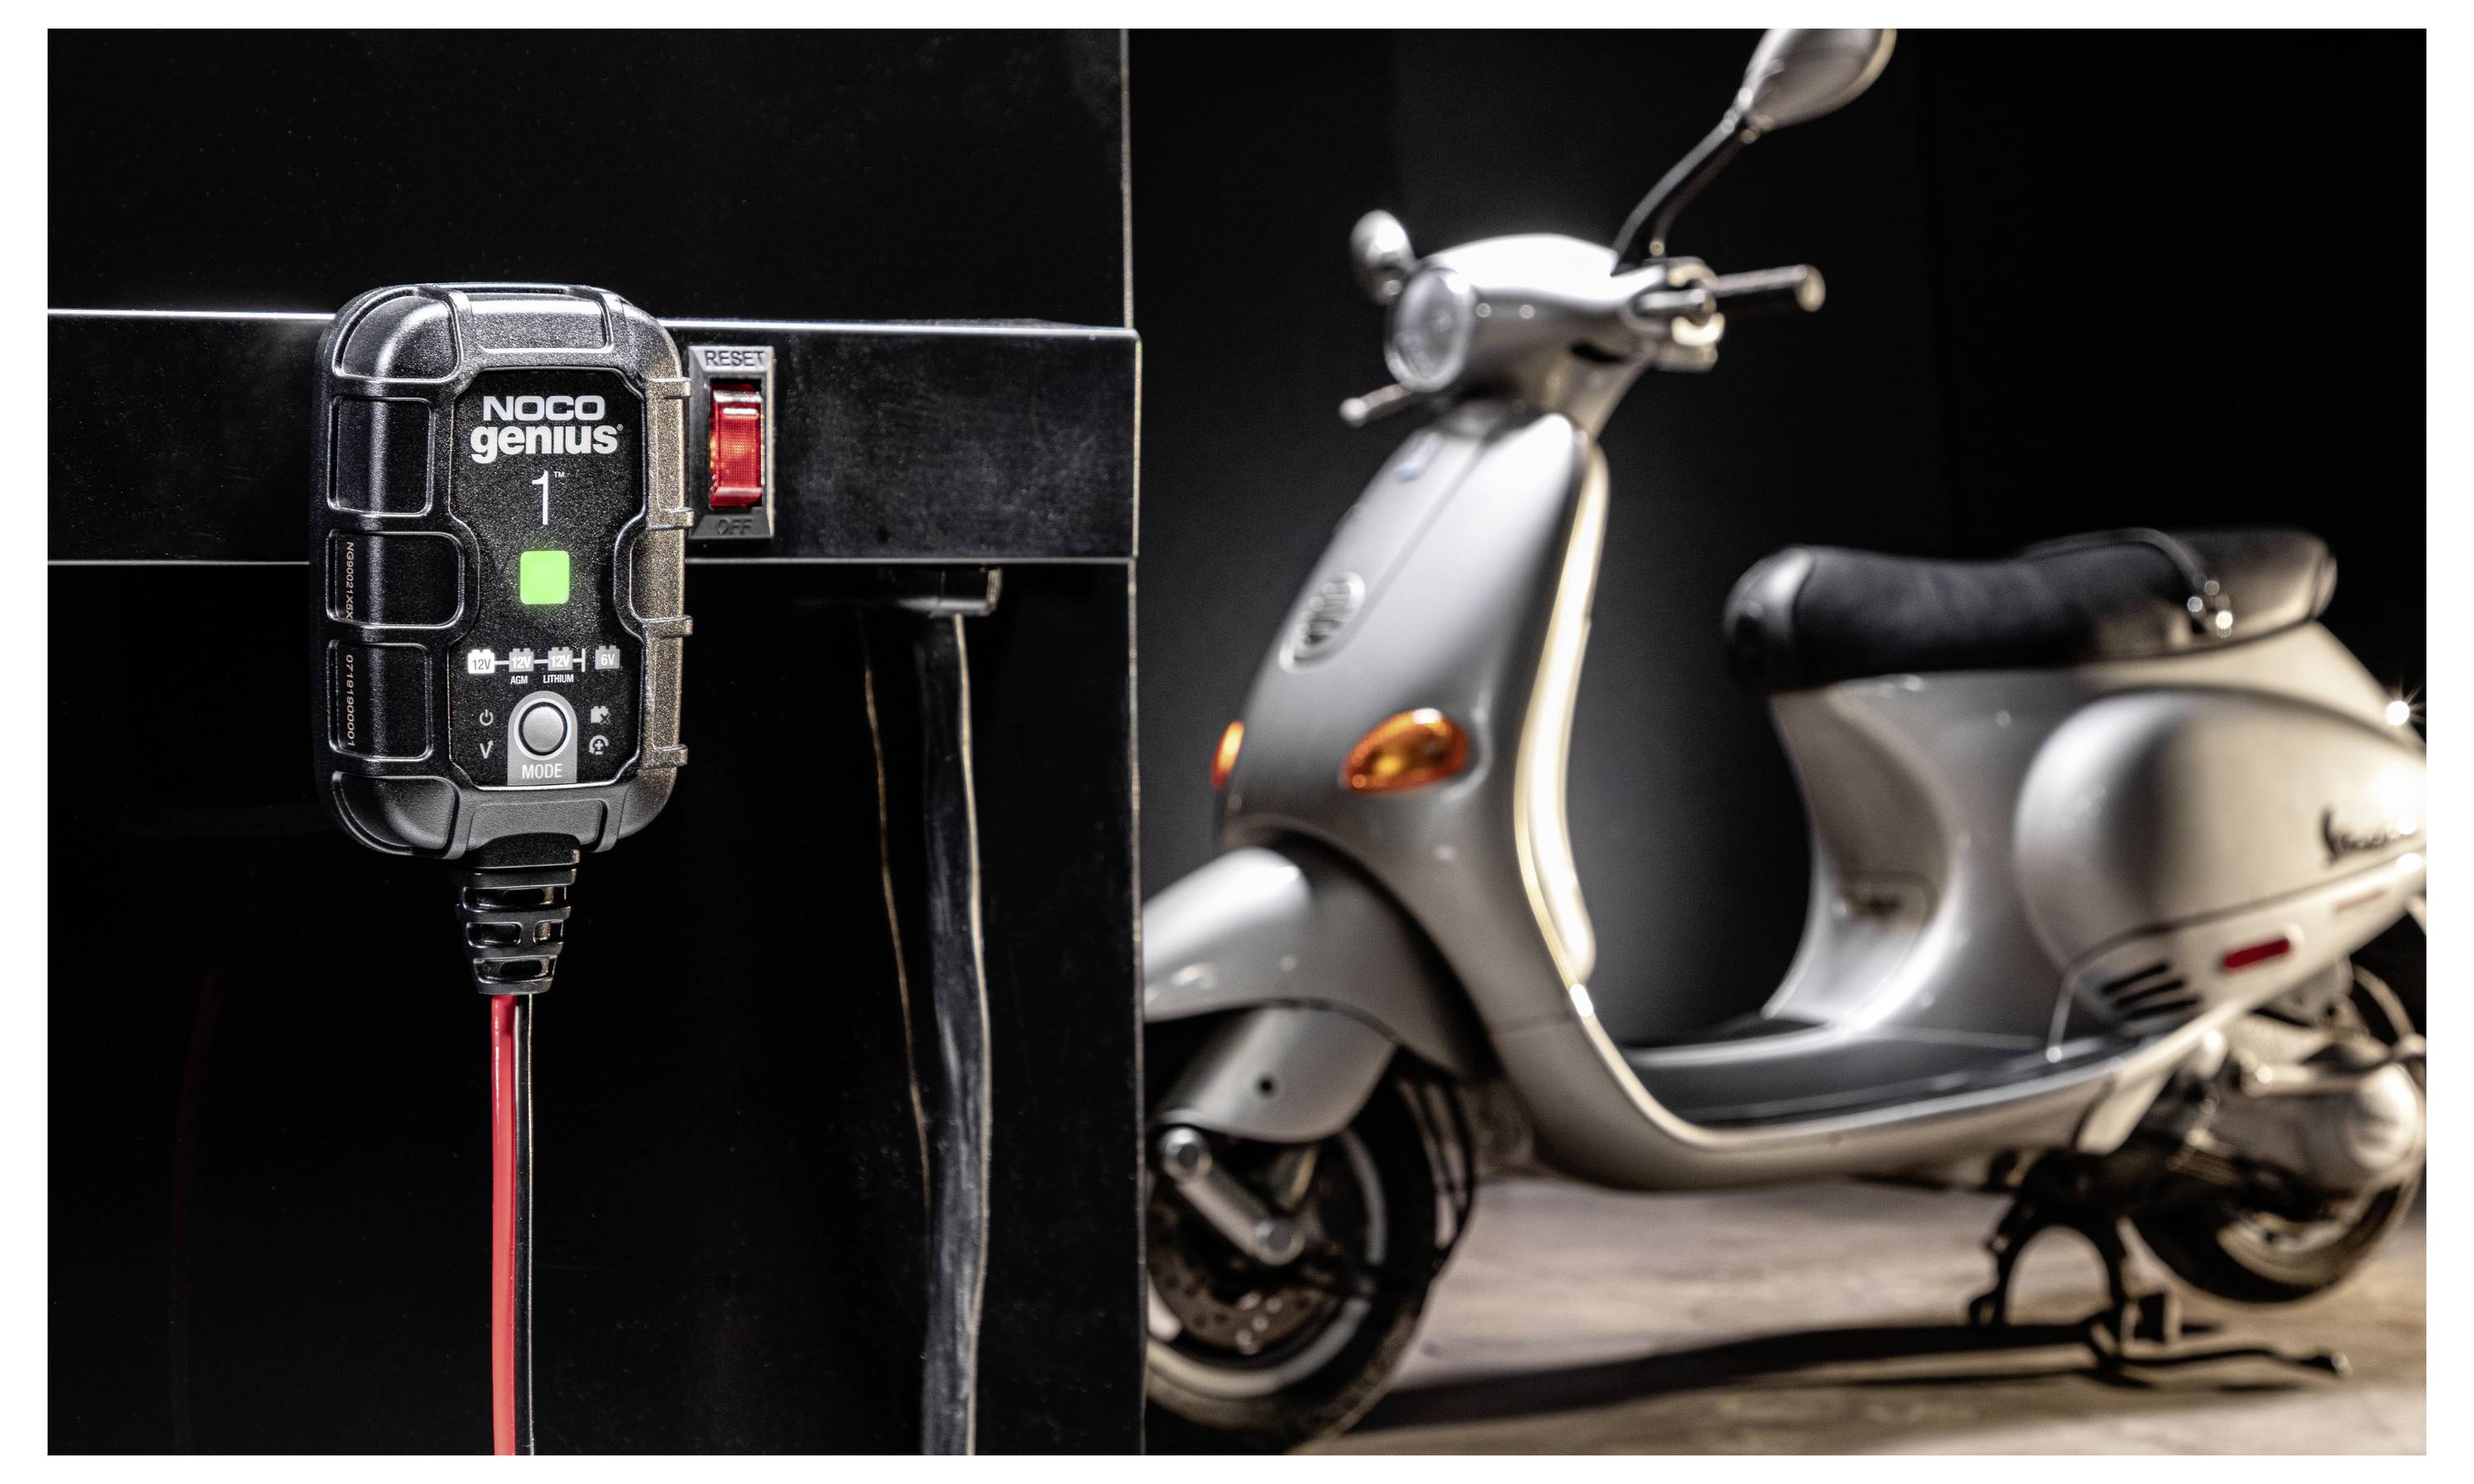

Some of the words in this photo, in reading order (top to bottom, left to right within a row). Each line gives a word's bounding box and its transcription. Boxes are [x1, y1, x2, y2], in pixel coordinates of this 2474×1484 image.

[704, 350, 764, 368] RESET
[482, 395, 605, 421] NOCO
[717, 517, 754, 535] OFF
[473, 658, 492, 670] 12V
[511, 655, 532, 669] 12V
[551, 654, 571, 668] 12V
[600, 653, 615, 666] 6V
[510, 674, 529, 685] AGM
[543, 673, 575, 684] LITHIUM
[346, 654, 356, 747] 07191900001
[521, 763, 563, 780] MODE
